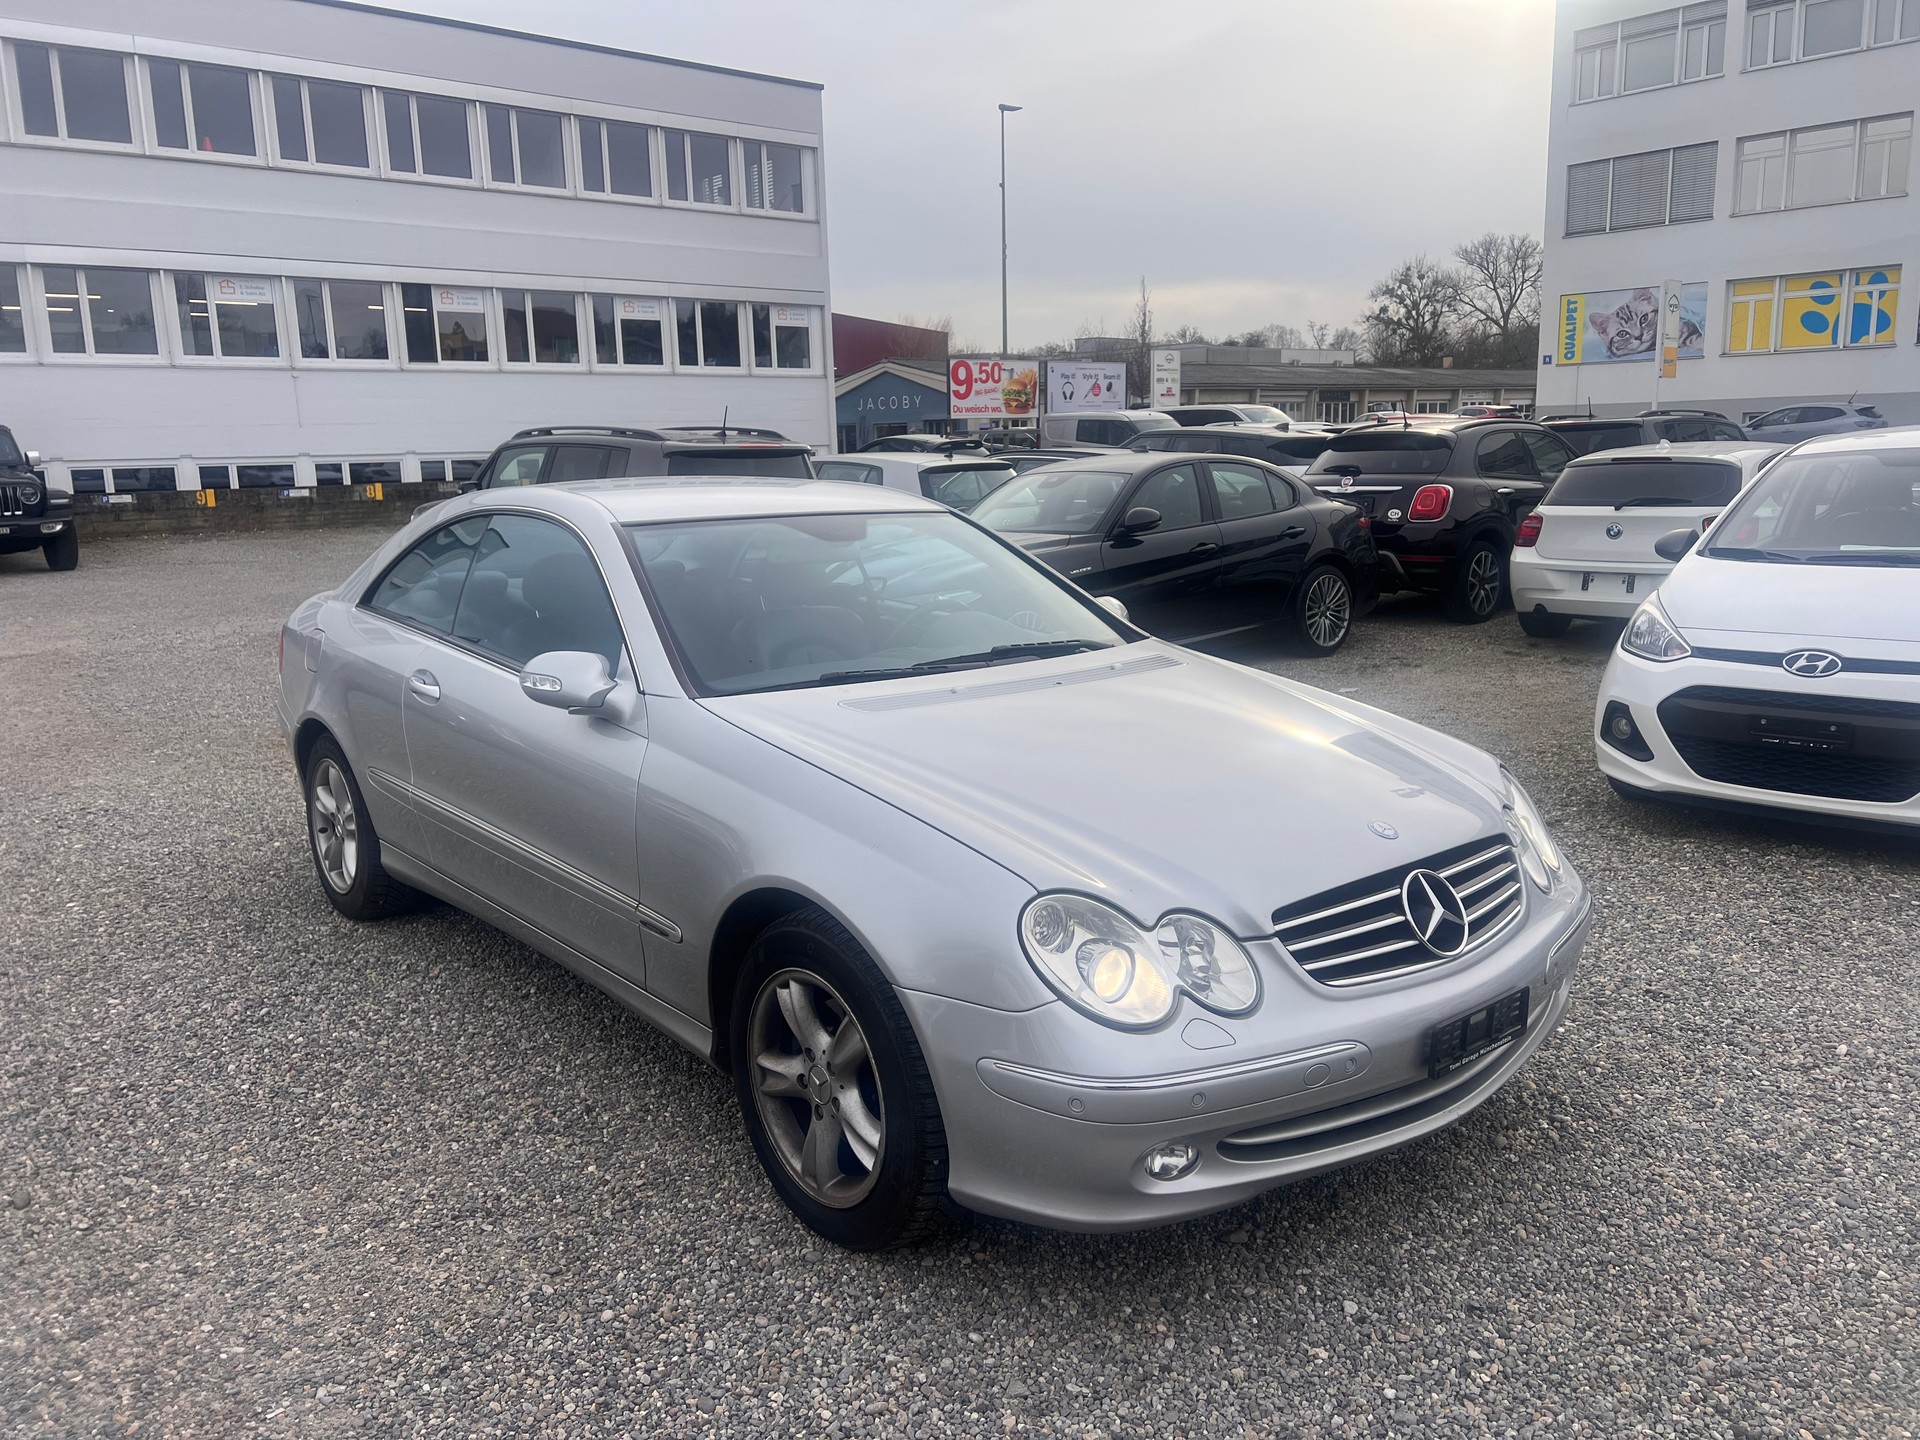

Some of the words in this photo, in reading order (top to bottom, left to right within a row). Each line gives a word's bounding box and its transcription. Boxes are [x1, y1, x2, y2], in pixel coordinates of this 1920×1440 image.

[1564, 299, 1578, 360] QUALIPET
[858, 395, 921, 410] JACOBY
[953, 405, 963, 413] Du
[964, 404, 990, 413] weisch
[990, 405, 1003, 413] wo.
[196, 490, 205, 505] 9
[366, 485, 375, 498] 8
[1462, 1053, 1478, 1064] Garage
[1480, 1036, 1511, 1055] Münchenstein
